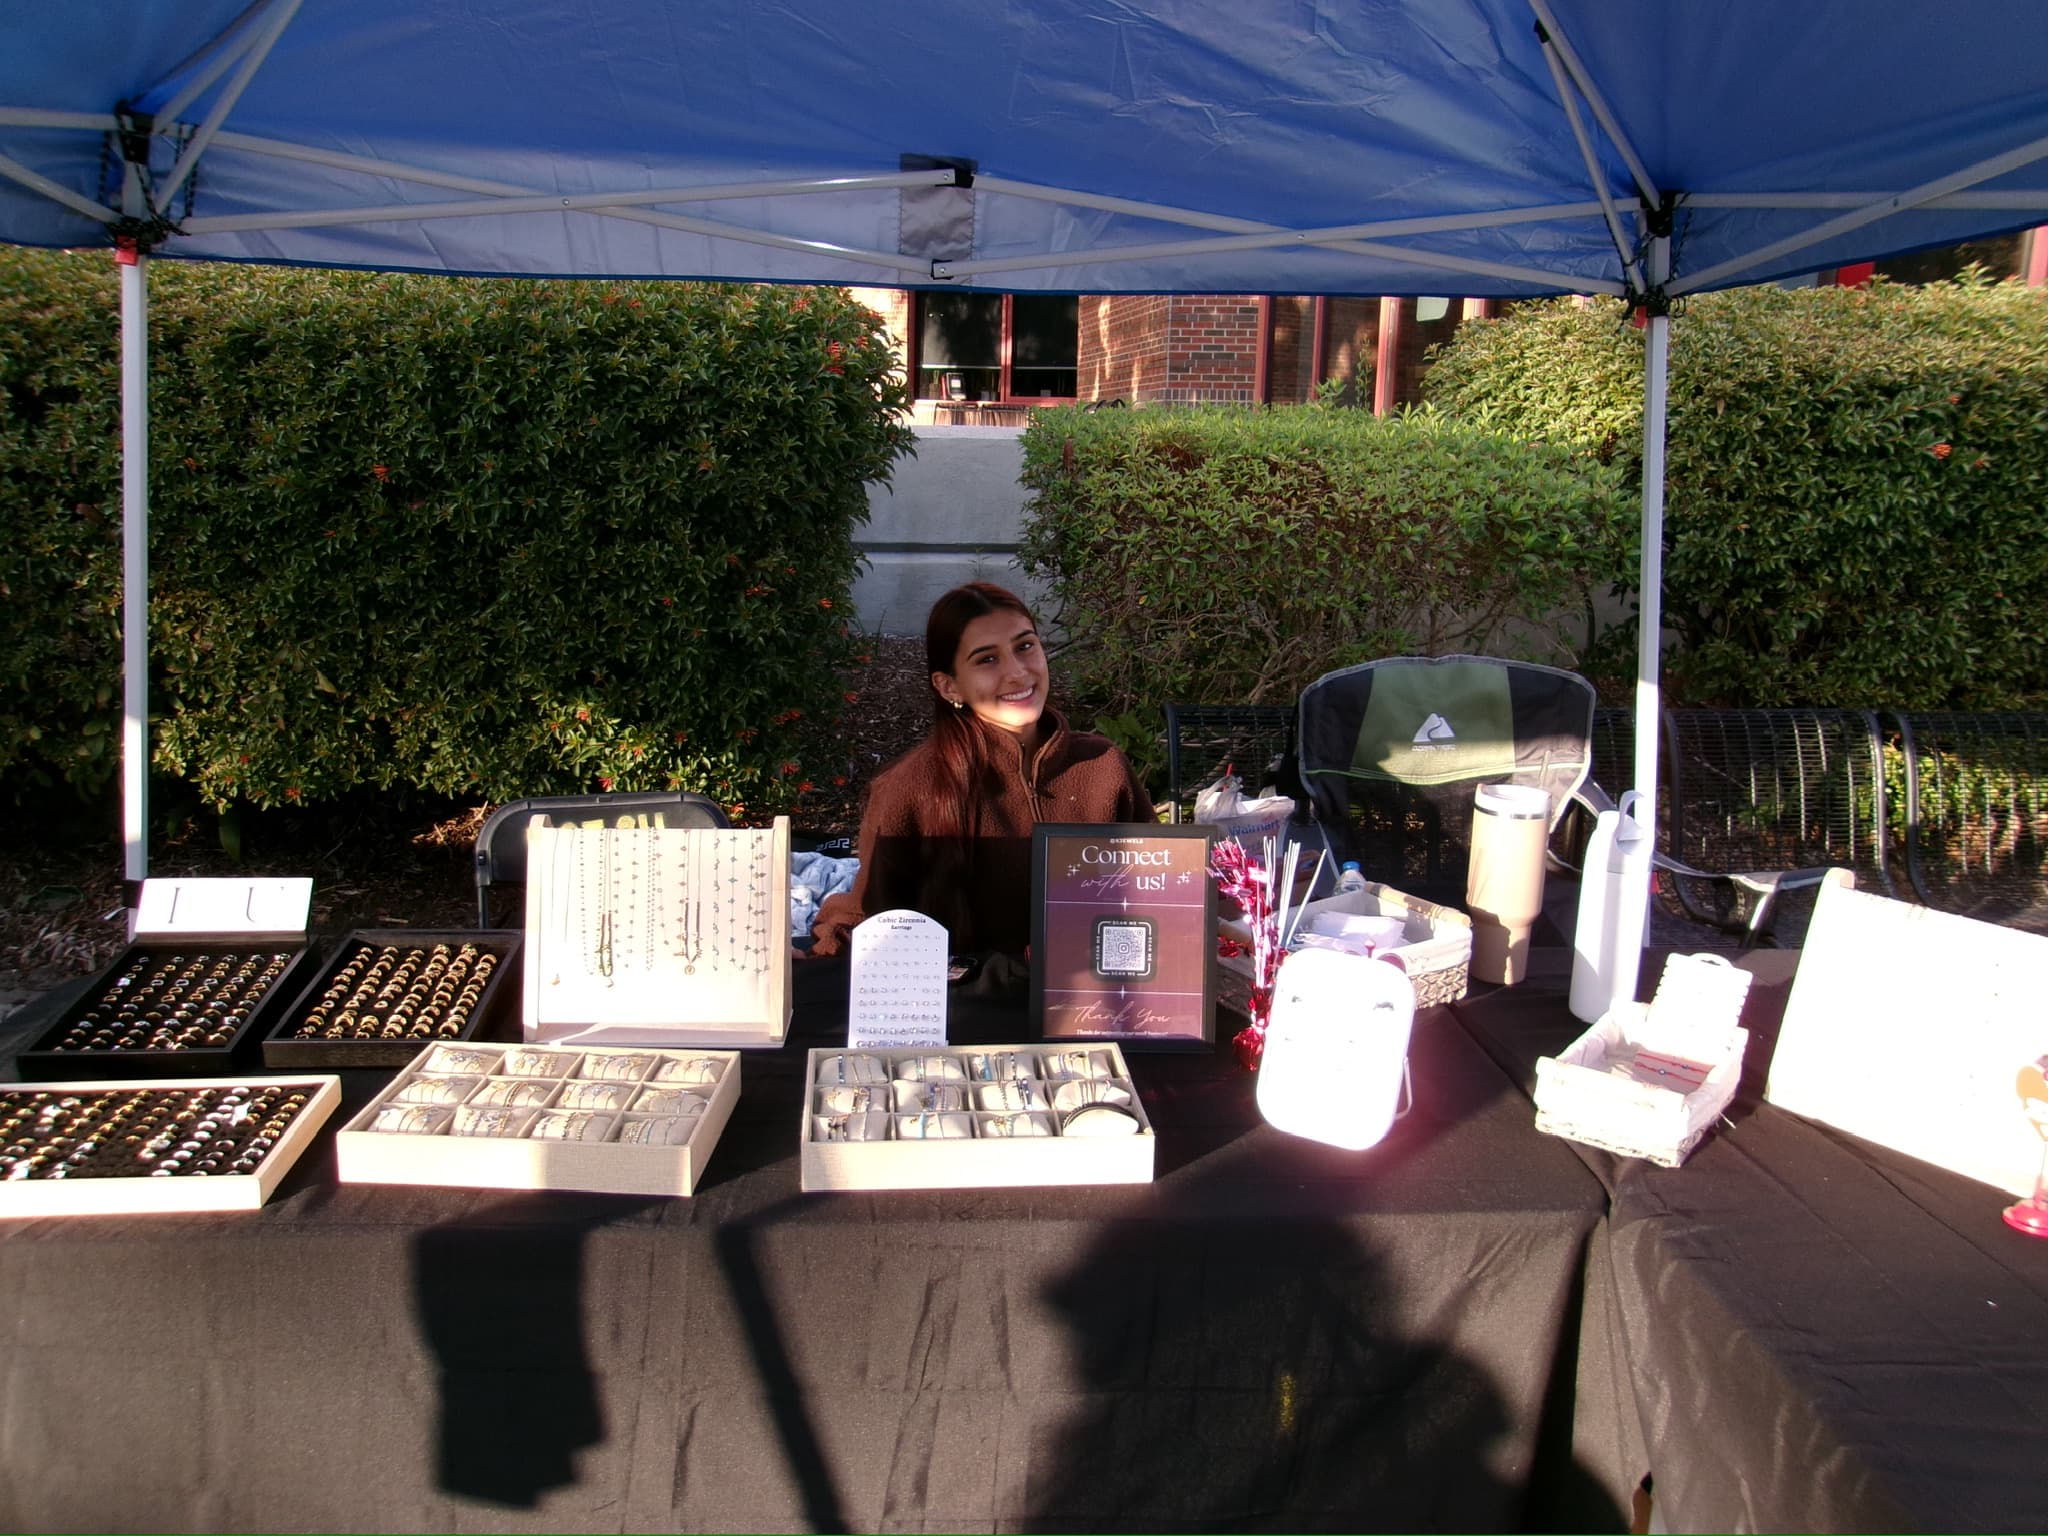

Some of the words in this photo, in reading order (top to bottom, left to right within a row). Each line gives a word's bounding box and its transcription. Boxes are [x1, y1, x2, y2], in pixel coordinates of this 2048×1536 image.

[1081, 845, 1172, 866] Connect
[1080, 863, 1130, 897] with
[1136, 872, 1166, 891] us!
[1055, 1000, 1134, 1025] Thank
[1133, 1007, 1172, 1030] You
